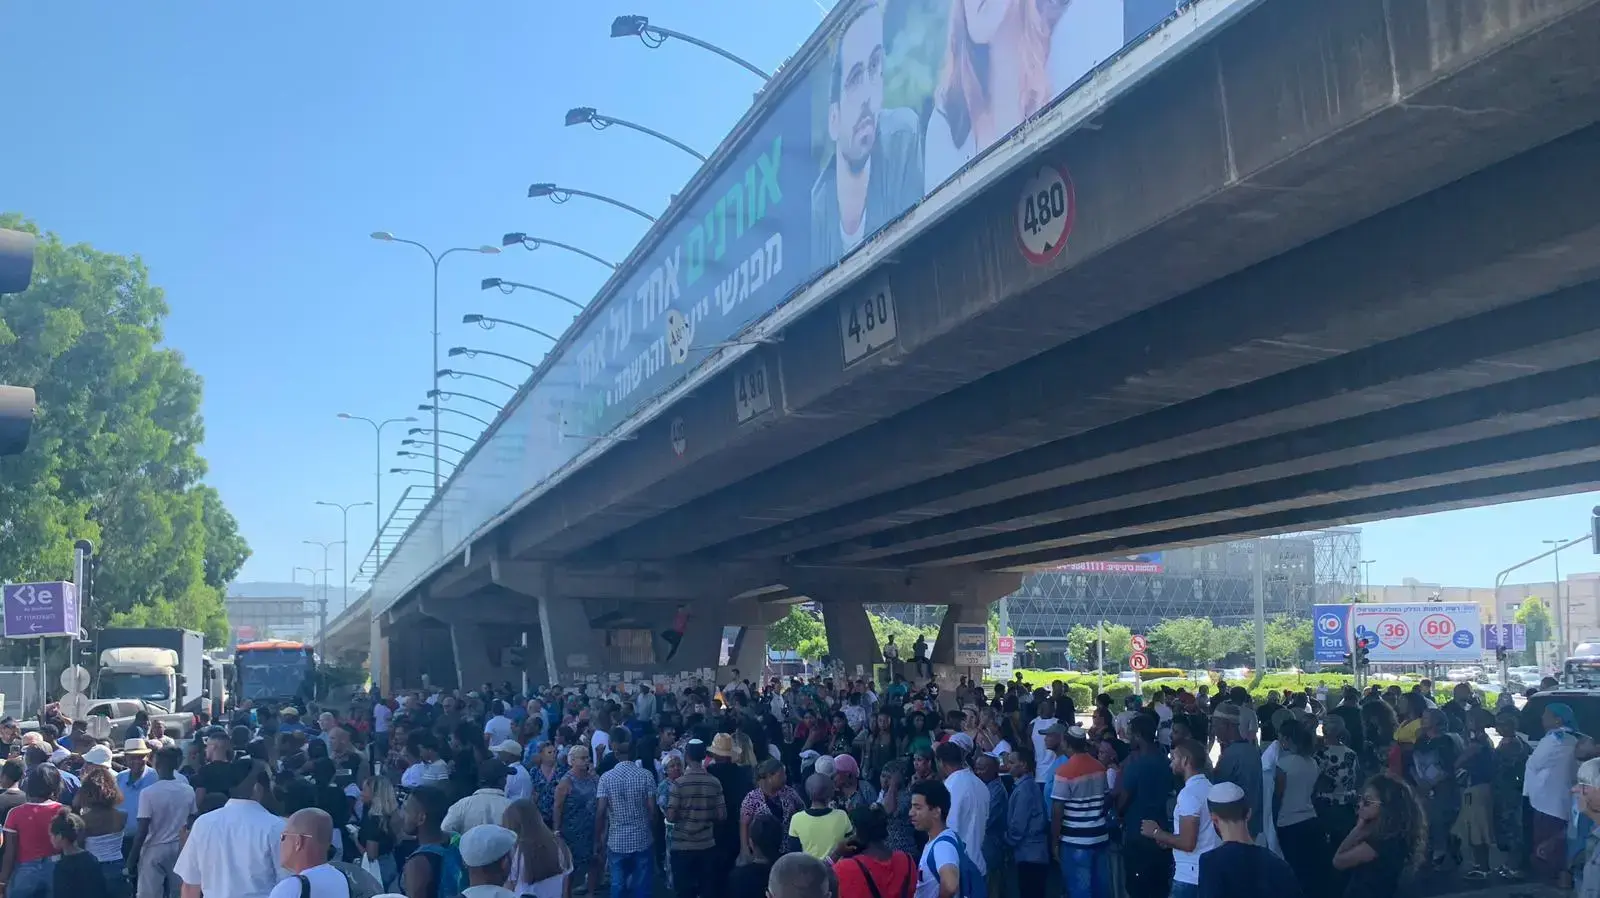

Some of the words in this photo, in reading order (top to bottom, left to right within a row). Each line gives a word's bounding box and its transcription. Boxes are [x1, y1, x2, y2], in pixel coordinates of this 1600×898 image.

[686, 135, 782, 288] אורנים
[637, 245, 681, 330] אחד
[714, 232, 783, 317] מפגשי
[848, 292, 888, 344] 4.80
[1318, 636, 1343, 648] Ten
